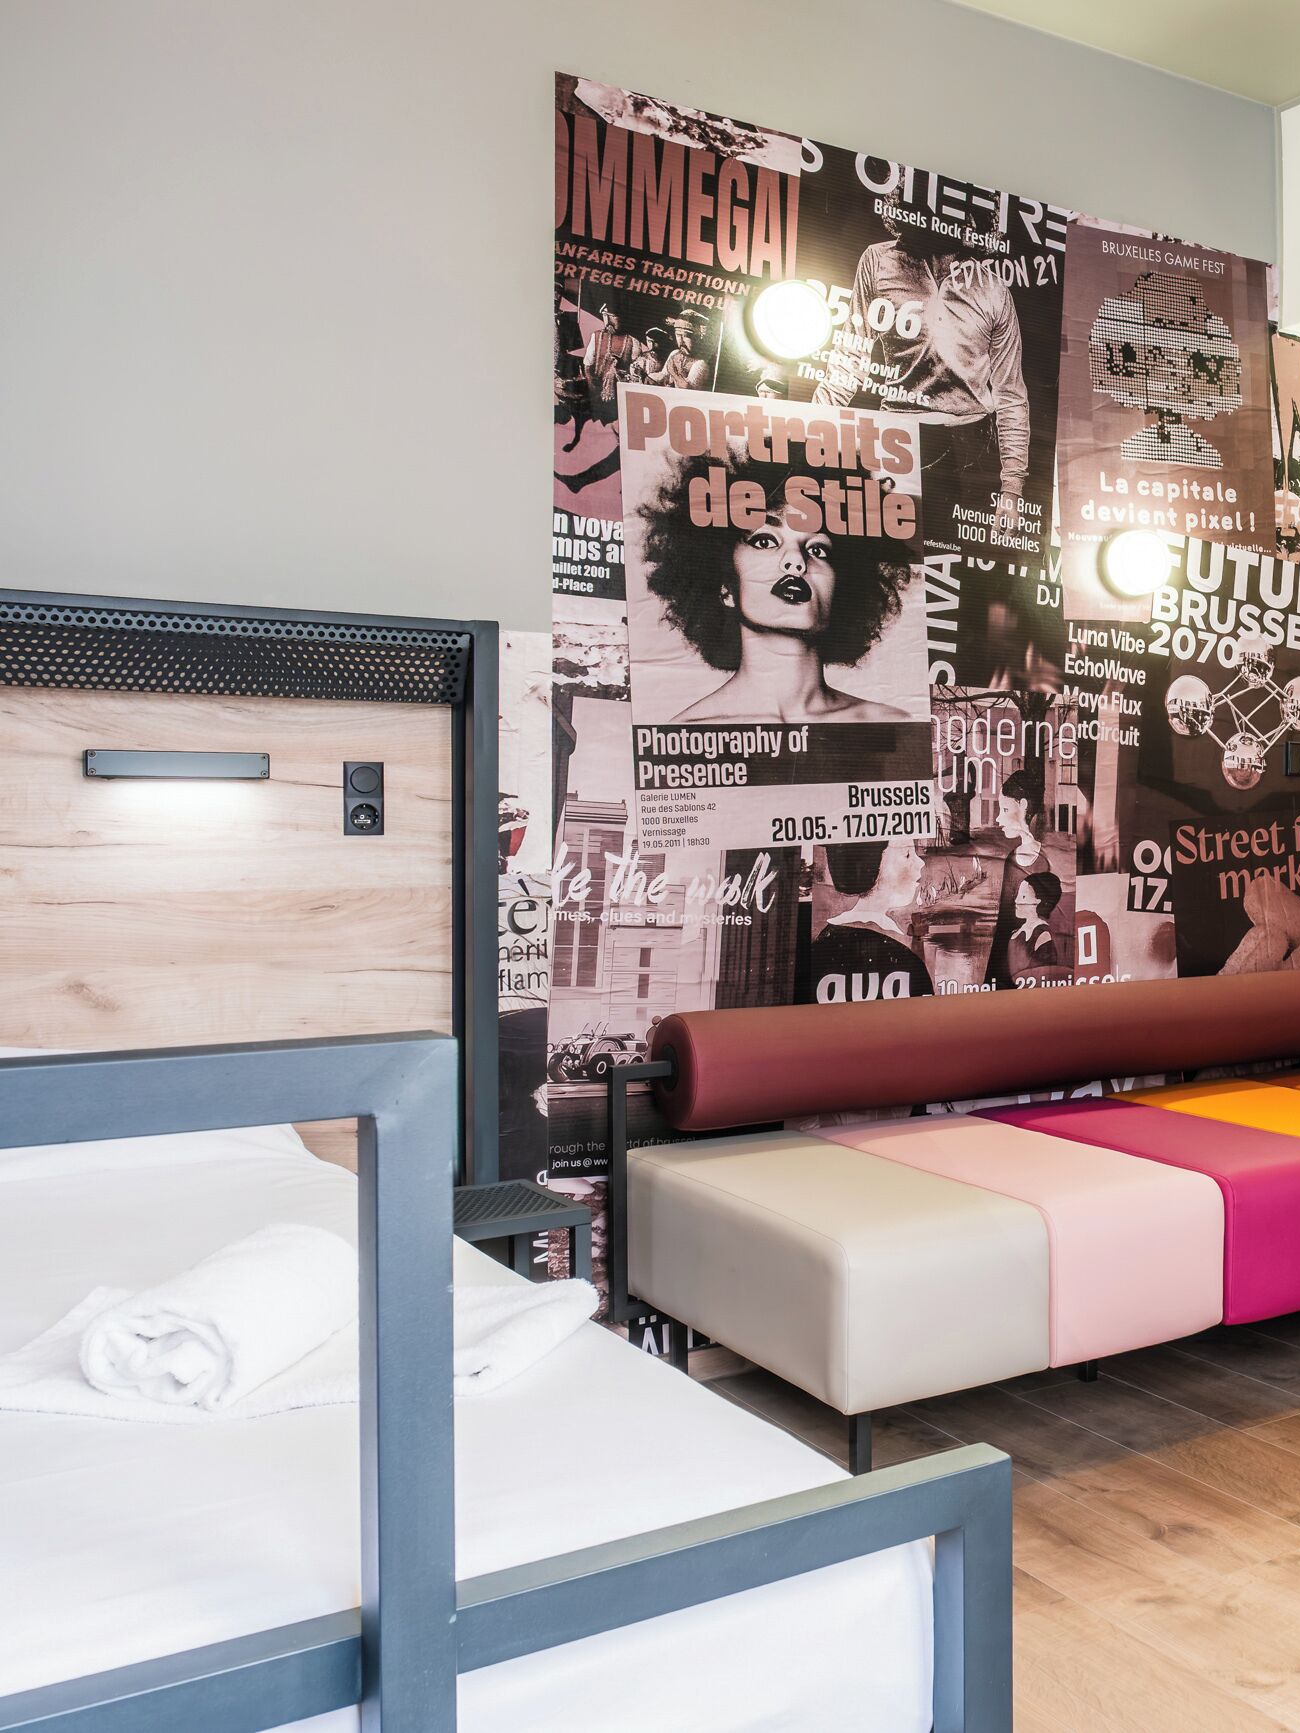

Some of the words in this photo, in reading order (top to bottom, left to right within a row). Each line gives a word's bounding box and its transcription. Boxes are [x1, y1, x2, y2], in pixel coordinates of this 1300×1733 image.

[874, 199, 927, 229] Brussels
[931, 216, 961, 240] Rock
[965, 229, 1010, 254] Festival
[950, 255, 1030, 290] EDITION
[1033, 254, 1058, 287] 21
[1102, 240, 1162, 263] BRUXELLES
[1165, 252, 1200, 269] GAME
[1202, 260, 1226, 275] FEST
[628, 278, 732, 311] HISTORIQU
[859, 357, 900, 380] Howl
[797, 361, 826, 381] The
[861, 377, 931, 407] Prophets
[625, 391, 914, 475] Portraits
[1100, 471, 1129, 495] La
[1136, 479, 1238, 503] capitale
[688, 467, 767, 531] de
[784, 475, 917, 540] Stile
[1017, 497, 1042, 516] Brux
[1080, 499, 1178, 527] devient
[1185, 508, 1243, 533] pixel
[952, 504, 996, 526] Avenue
[999, 513, 1014, 529] du
[1018, 516, 1042, 535] Port
[957, 523, 986, 543] 1000
[990, 531, 1040, 553] Bruxelles
[584, 565, 611, 579] 2001
[1036, 585, 1061, 608] DJ
[1068, 622, 1108, 648] Luna
[1110, 628, 1145, 655] Vibe
[1148, 621, 1240, 669] 2070
[1064, 653, 1147, 686] EchoWave
[1111, 691, 1142, 717] Flux
[637, 726, 782, 757] Photography
[788, 726, 809, 752] of
[638, 762, 748, 788] Presence
[640, 793, 669, 802] Galerie
[670, 792, 696, 801] LUMEN
[641, 805, 657, 814] Rue
[658, 804, 673, 813] des
[674, 803, 706, 813] Sablons
[707, 803, 716, 811] 42
[848, 782, 931, 808] Brussels
[642, 828, 686, 837] Vernissage
[662, 815, 699, 824] Bruxelles
[842, 811, 931, 838] 17.07.2011
[642, 839, 681, 849] 19.05.2011
[687, 838, 710, 847] 18h30
[1175, 820, 1285, 865] Street
[604, 843, 669, 906] the
[600, 910, 642, 924] clues
[647, 912, 677, 924] and
[680, 912, 752, 927] mysteries
[586, 1141, 606, 1152] the
[552, 1159, 569, 1169] join
[571, 1159, 581, 1167] us
[582, 1158, 593, 1168] @
